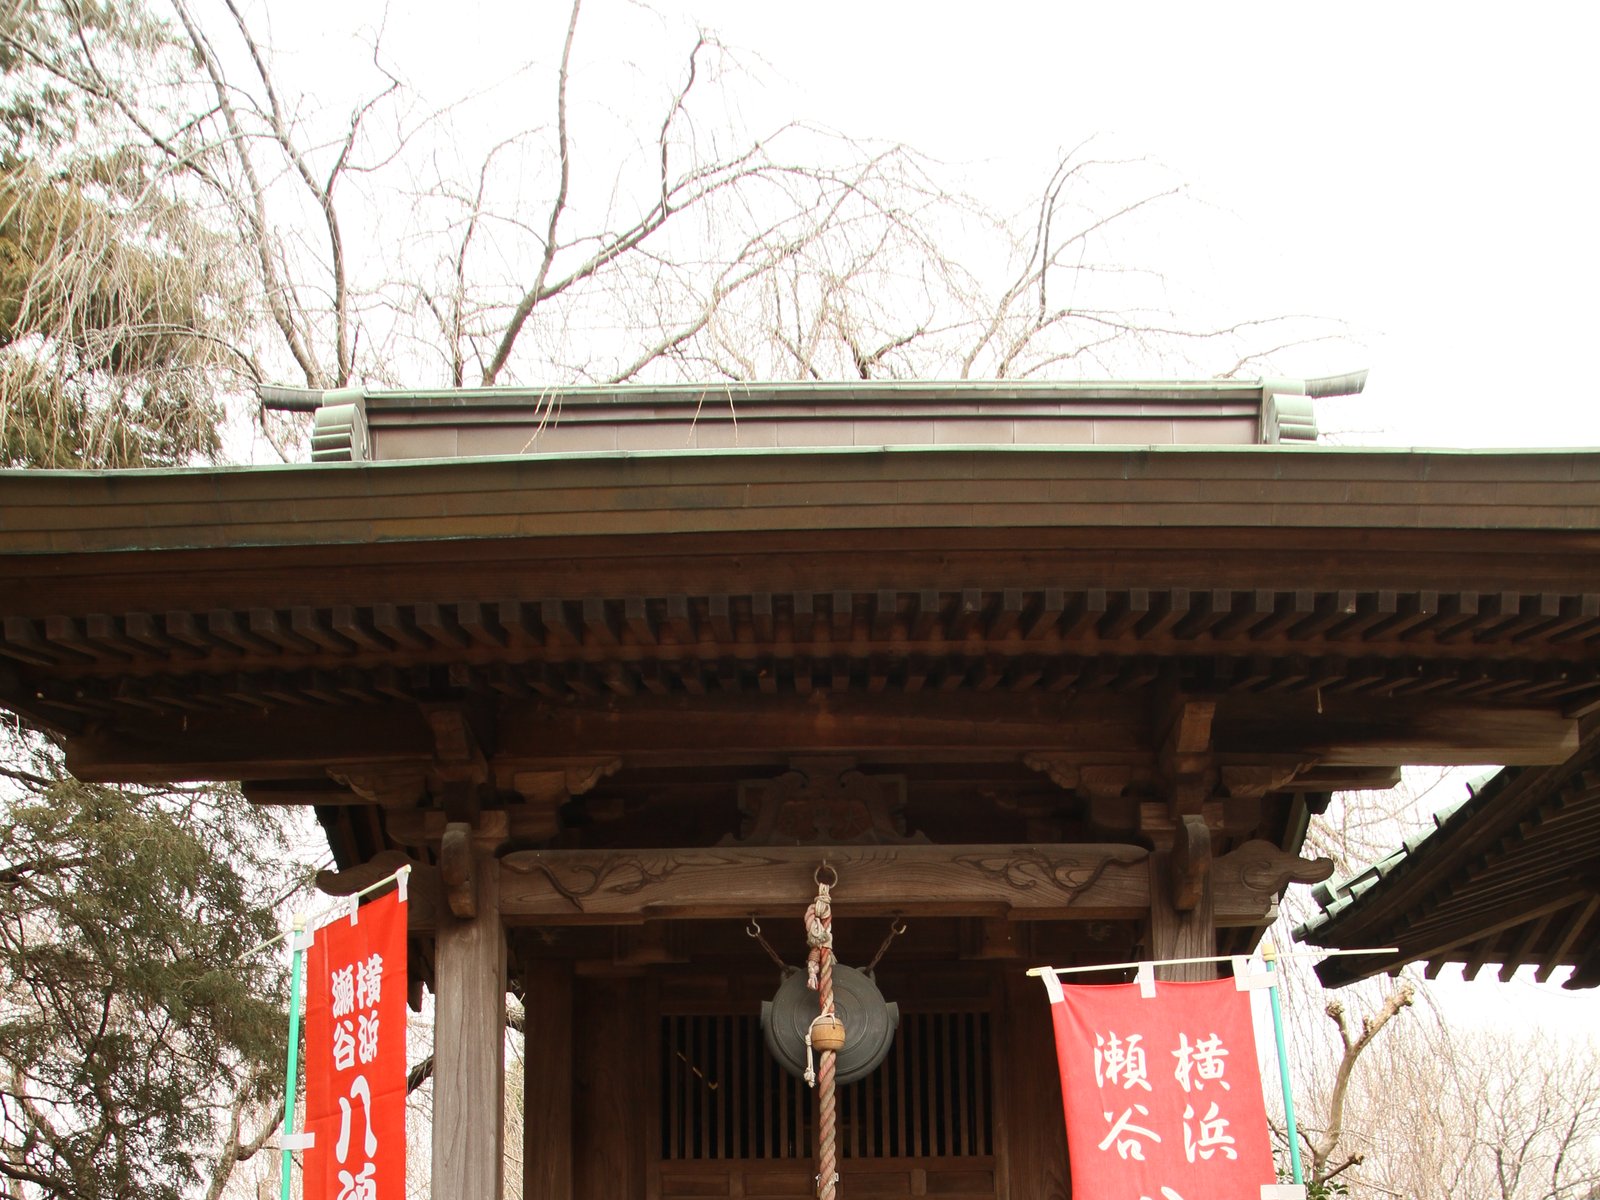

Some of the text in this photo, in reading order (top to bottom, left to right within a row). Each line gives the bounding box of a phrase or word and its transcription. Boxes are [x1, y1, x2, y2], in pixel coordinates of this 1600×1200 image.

[331, 964, 355, 1072] 瀬谷
[356, 953, 384, 1065] 横浜
[1093, 1031, 1162, 1161] 瀬谷
[1172, 1032, 1238, 1163] 横浜
